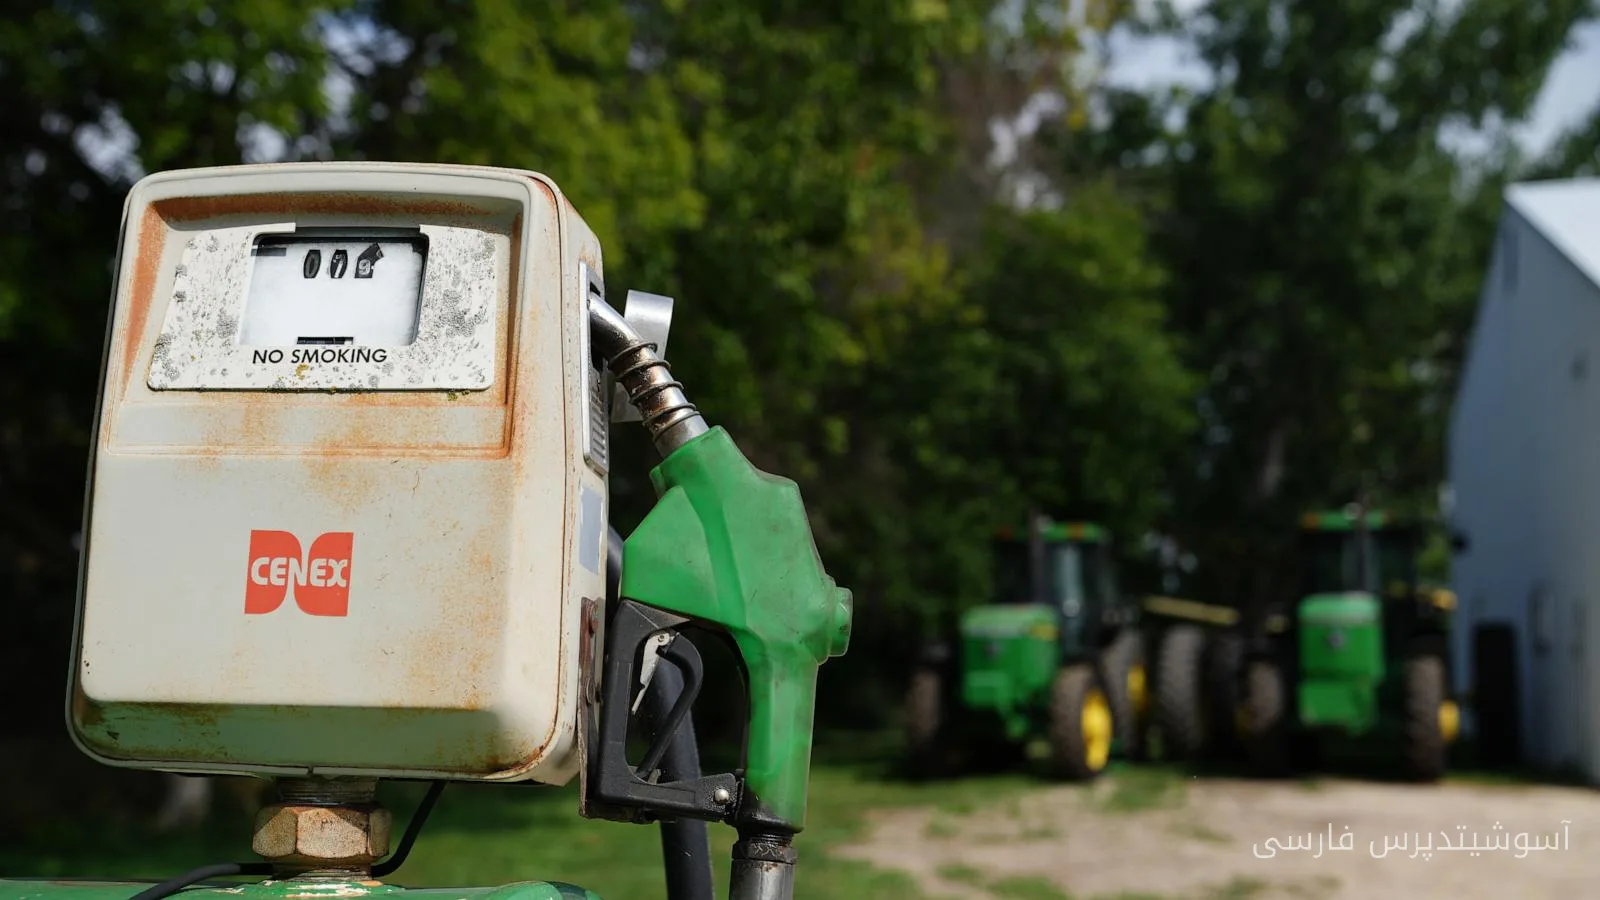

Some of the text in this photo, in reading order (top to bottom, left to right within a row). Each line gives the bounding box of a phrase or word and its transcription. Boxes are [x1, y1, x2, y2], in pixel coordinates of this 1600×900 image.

[252, 348, 387, 364] NO SMOKING
[251, 556, 348, 588] CENEX
